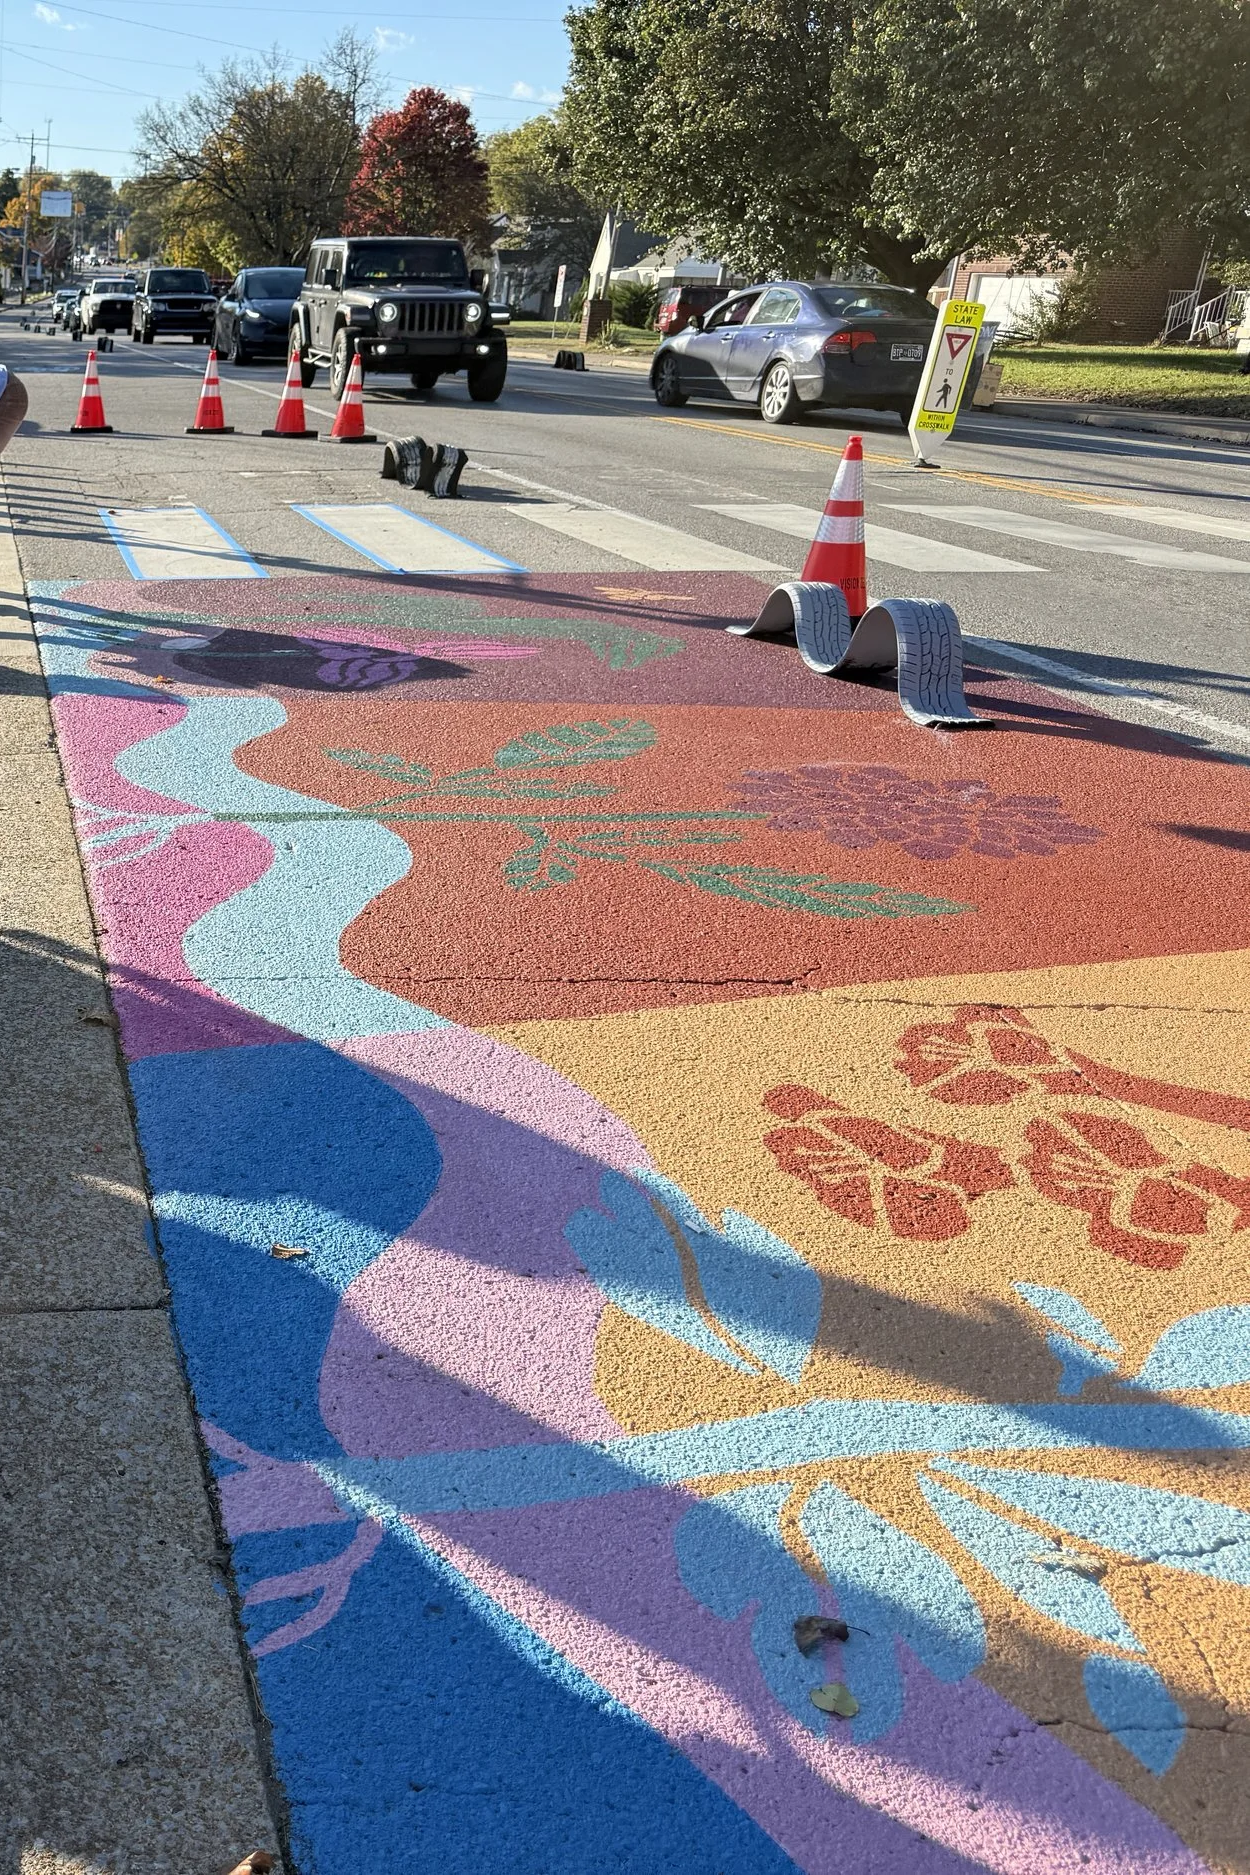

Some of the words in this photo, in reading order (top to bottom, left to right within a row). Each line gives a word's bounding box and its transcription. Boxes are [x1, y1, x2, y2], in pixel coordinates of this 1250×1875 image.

[952, 304, 980, 316] STATE
[954, 315, 973, 325] LAW
[927, 414, 946, 422] WITHIN
[918, 421, 950, 431] CROSSWALK
[839, 577, 859, 590] VISION
